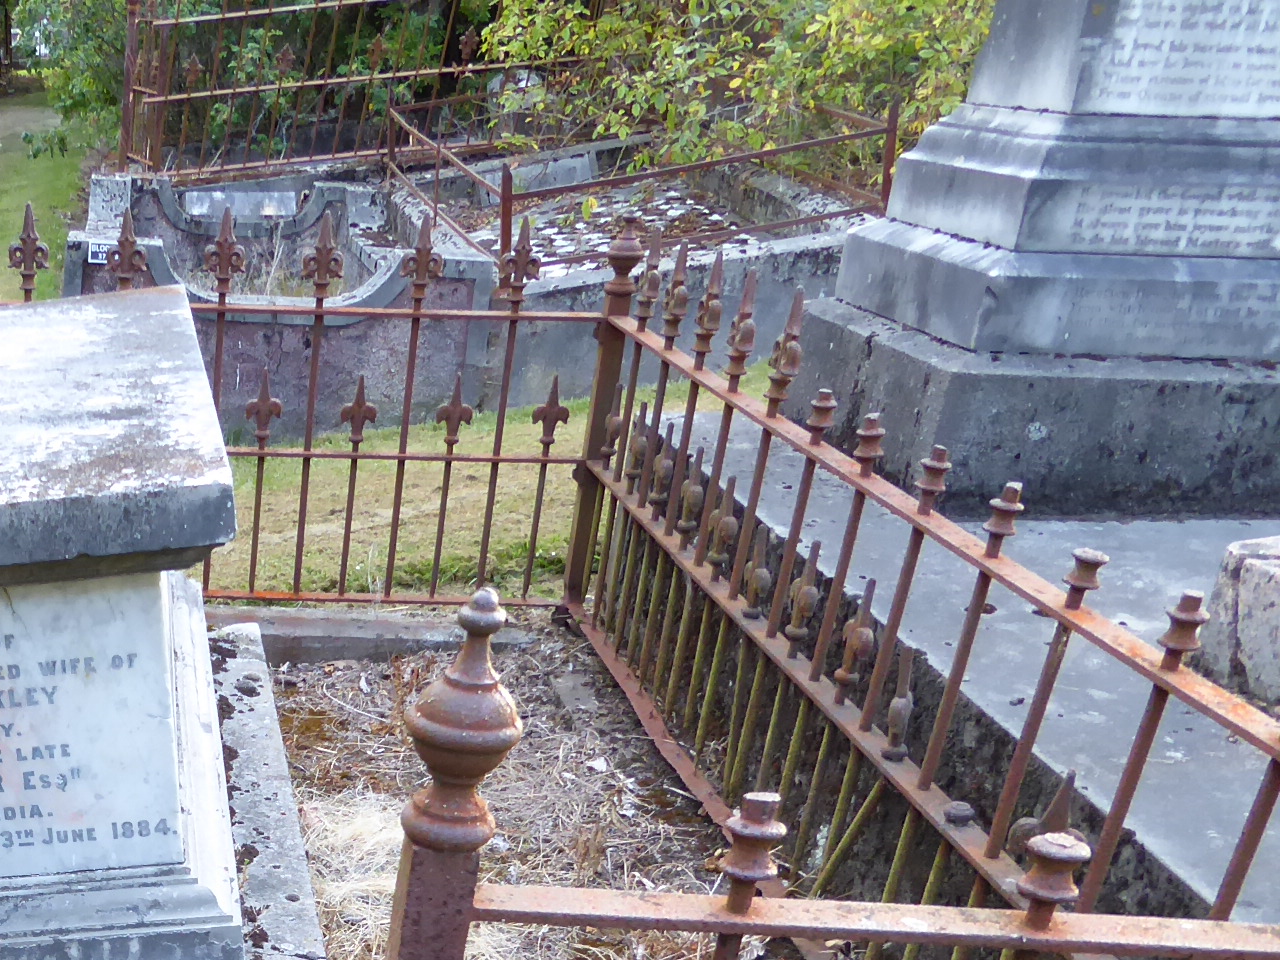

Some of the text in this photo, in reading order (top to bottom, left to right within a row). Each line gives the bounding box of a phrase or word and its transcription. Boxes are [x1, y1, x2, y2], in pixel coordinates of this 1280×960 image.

[38, 656, 96, 677] WIFE
[111, 653, 138, 669] OF
[16, 743, 71, 762] LATE
[41, 827, 98, 845] JUNE
[111, 817, 179, 840] 1884.
